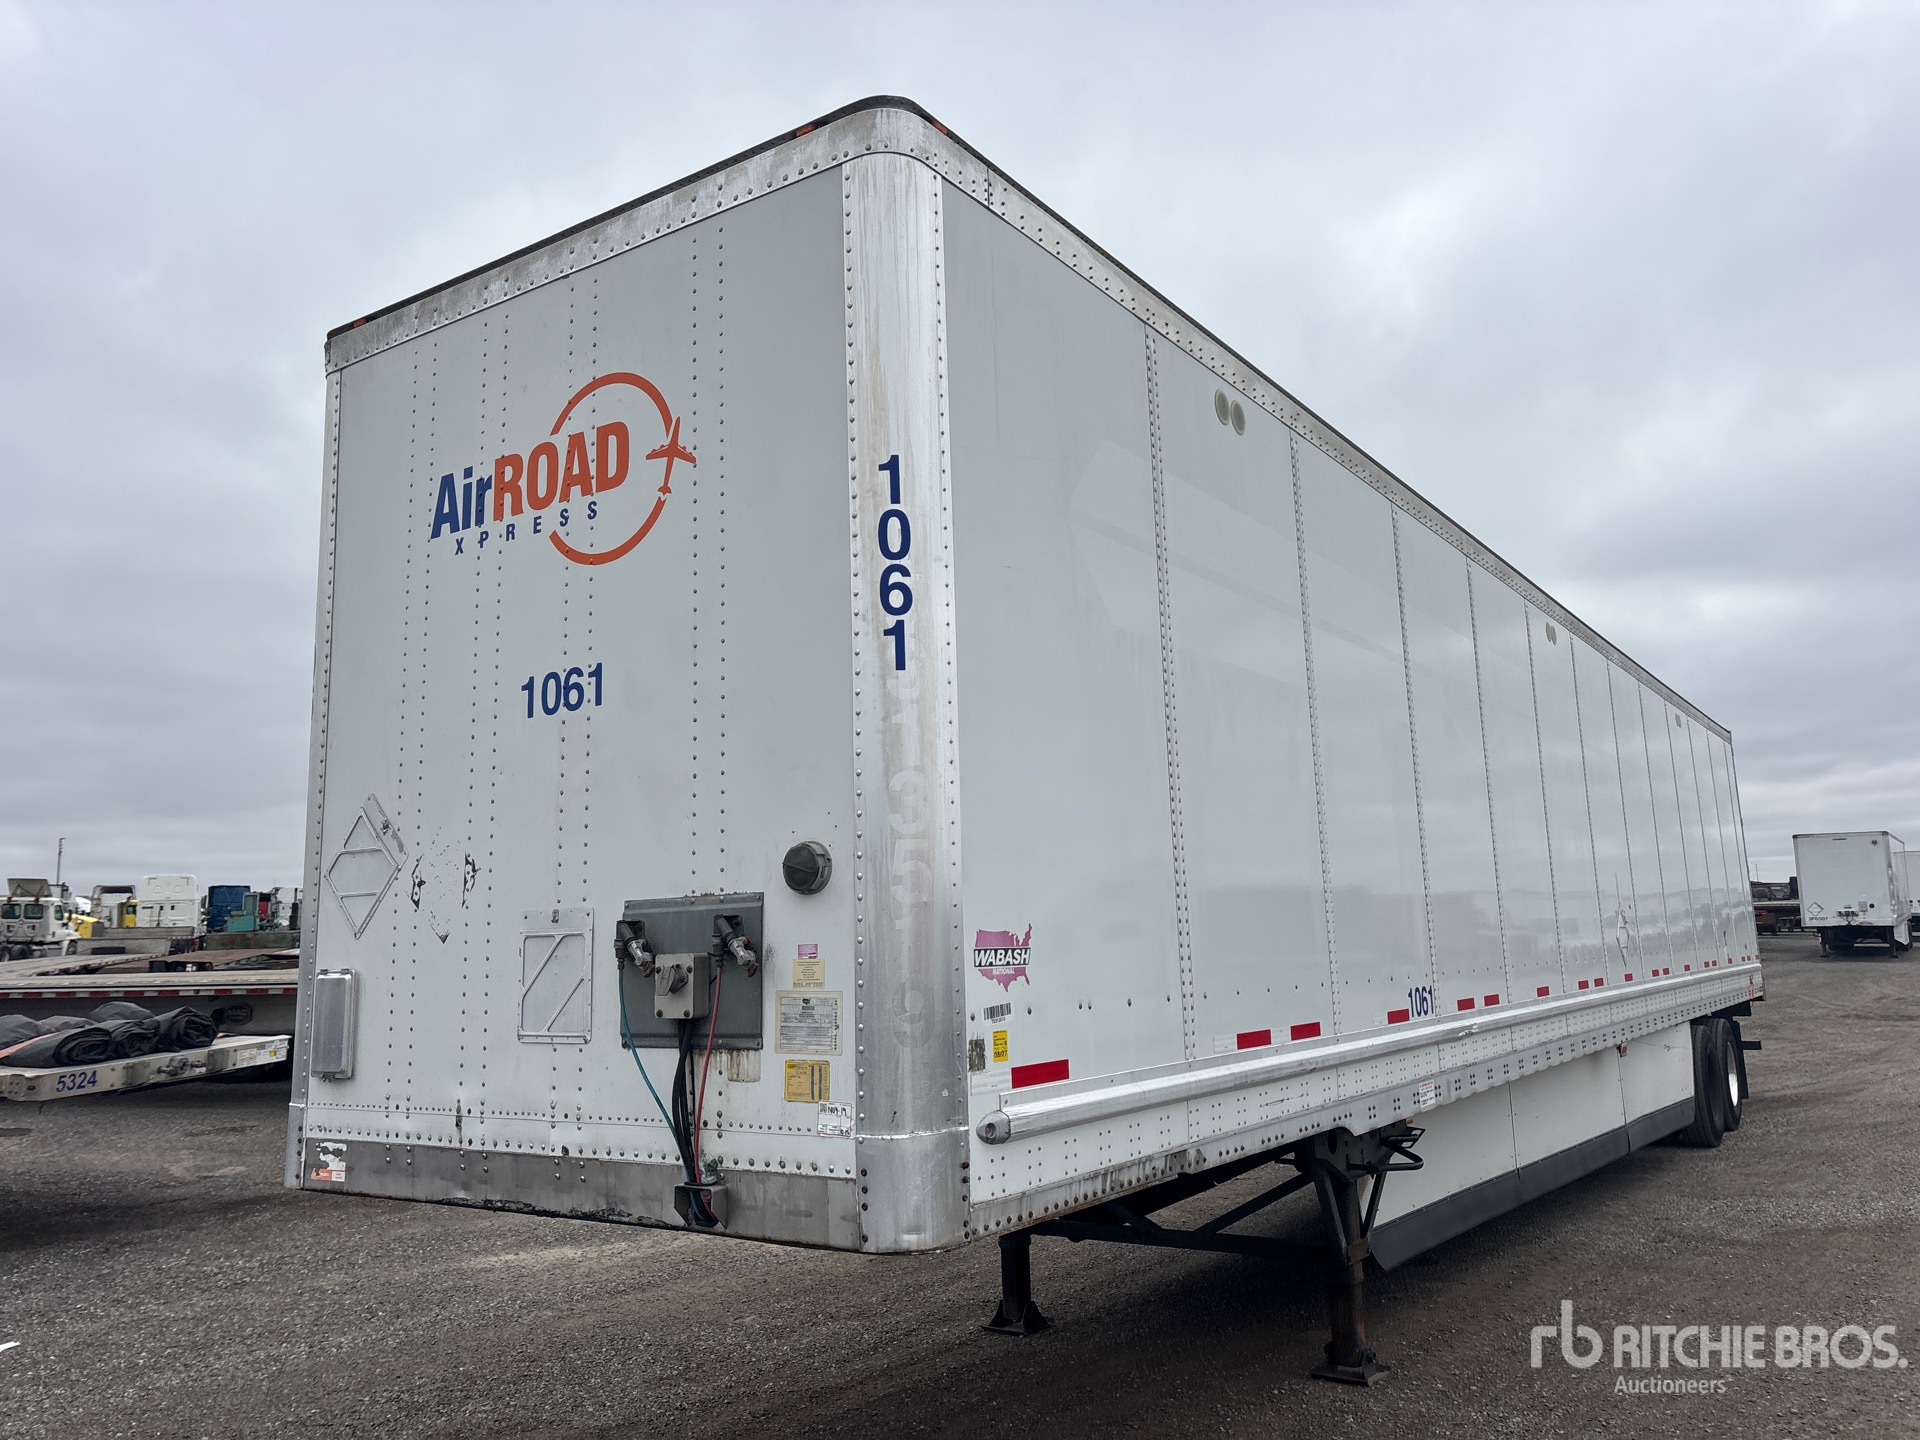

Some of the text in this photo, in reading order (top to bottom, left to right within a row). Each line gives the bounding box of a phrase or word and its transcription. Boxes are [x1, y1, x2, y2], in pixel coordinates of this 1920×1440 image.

[430, 421, 630, 540] AirROAD
[454, 500, 598, 556] XPRESS
[878, 454, 913, 671] 1061
[521, 662, 603, 719] 1061
[974, 949, 1030, 967] WABASH
[1408, 985, 1434, 1018] 1061
[56, 1070, 98, 1093] 5324
